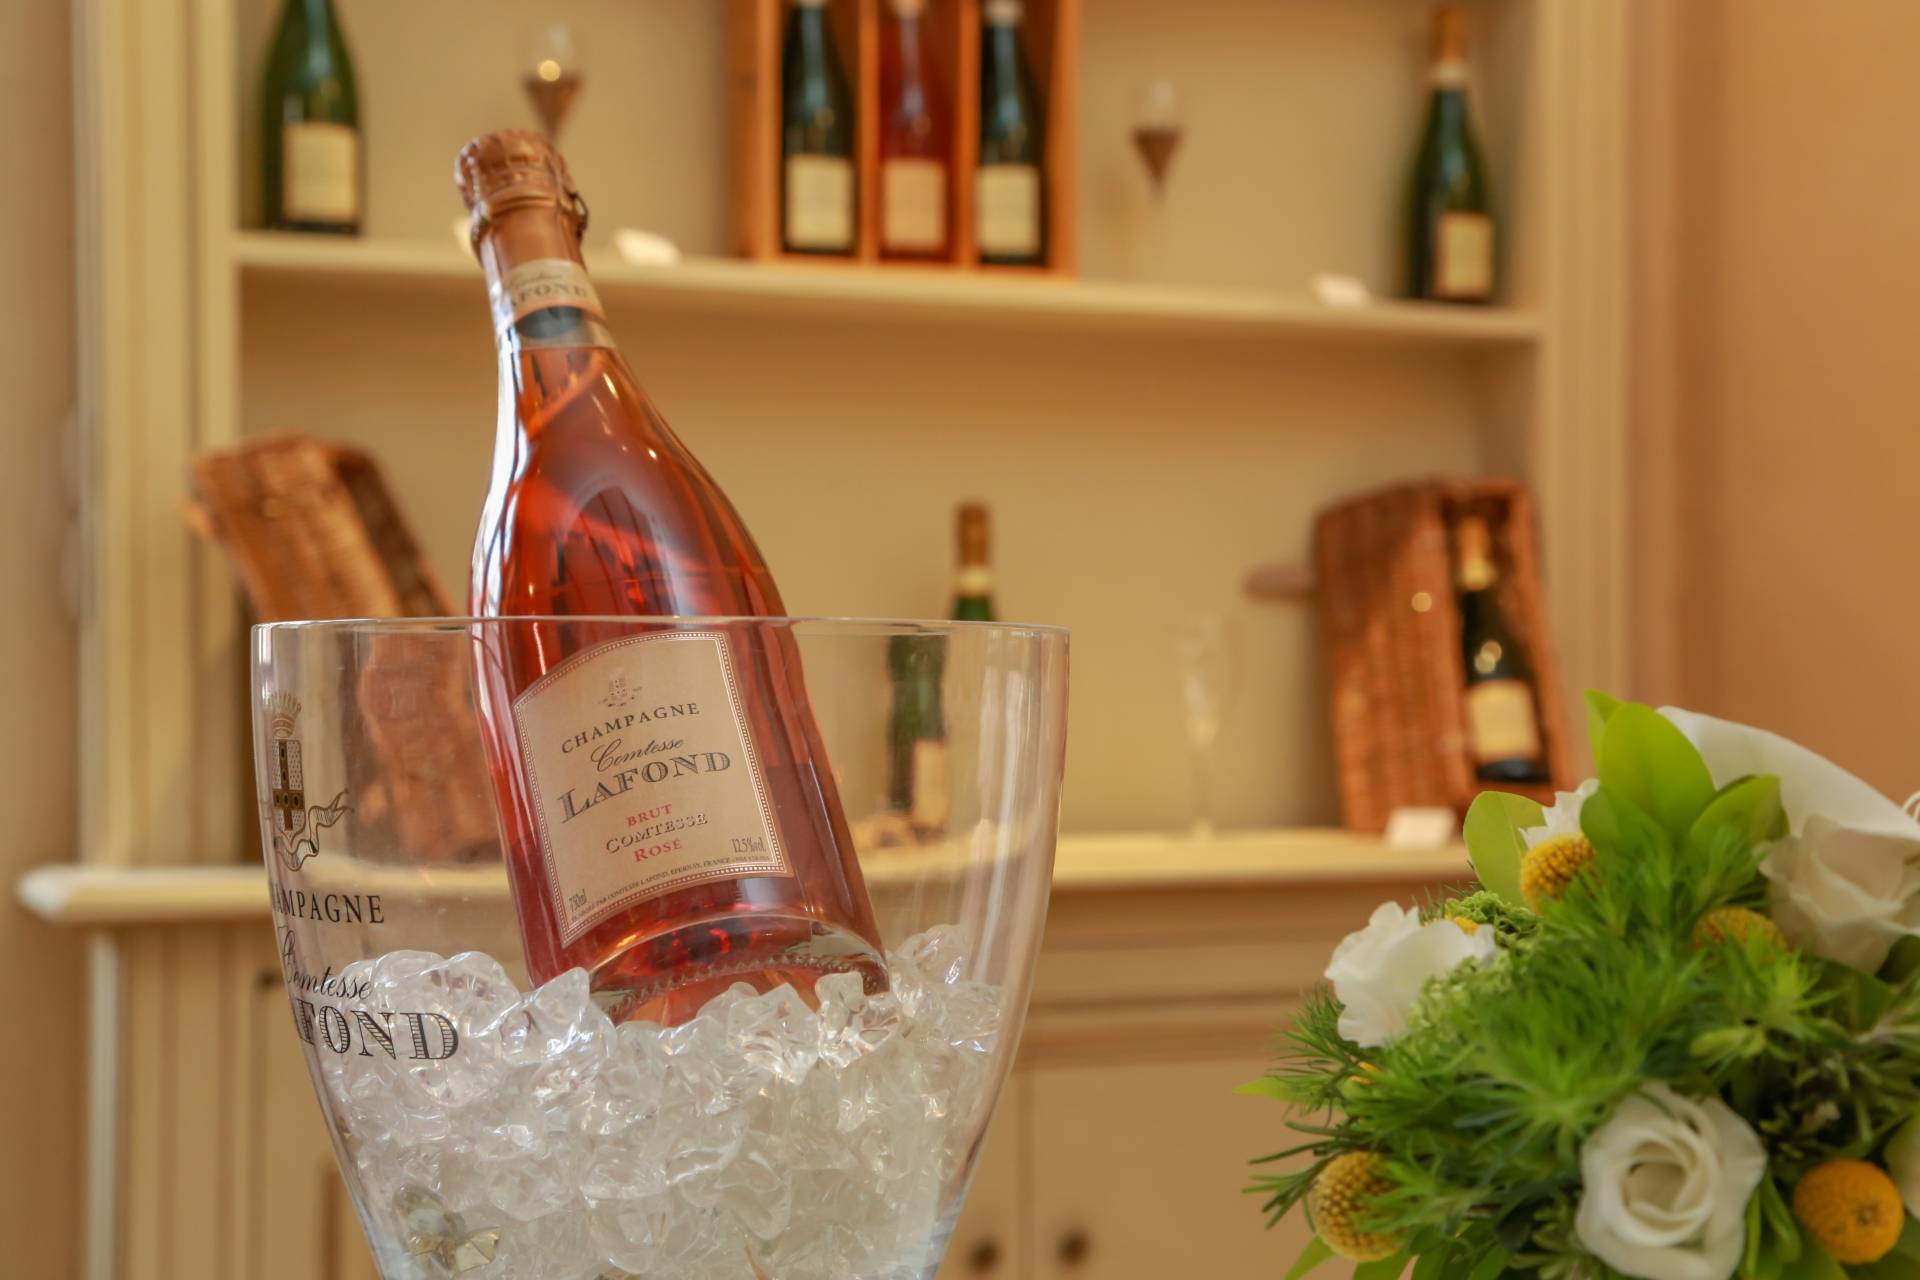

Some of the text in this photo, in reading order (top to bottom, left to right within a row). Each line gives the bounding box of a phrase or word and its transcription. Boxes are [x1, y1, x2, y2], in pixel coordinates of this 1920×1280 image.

[561, 702, 700, 754] CHAMPAGNE
[591, 738, 685, 773] Comtesse
[557, 751, 731, 821] LAFOND
[605, 813, 708, 855] COMTESSE
[626, 803, 673, 828] BRUT
[293, 998, 459, 1061] FOND
